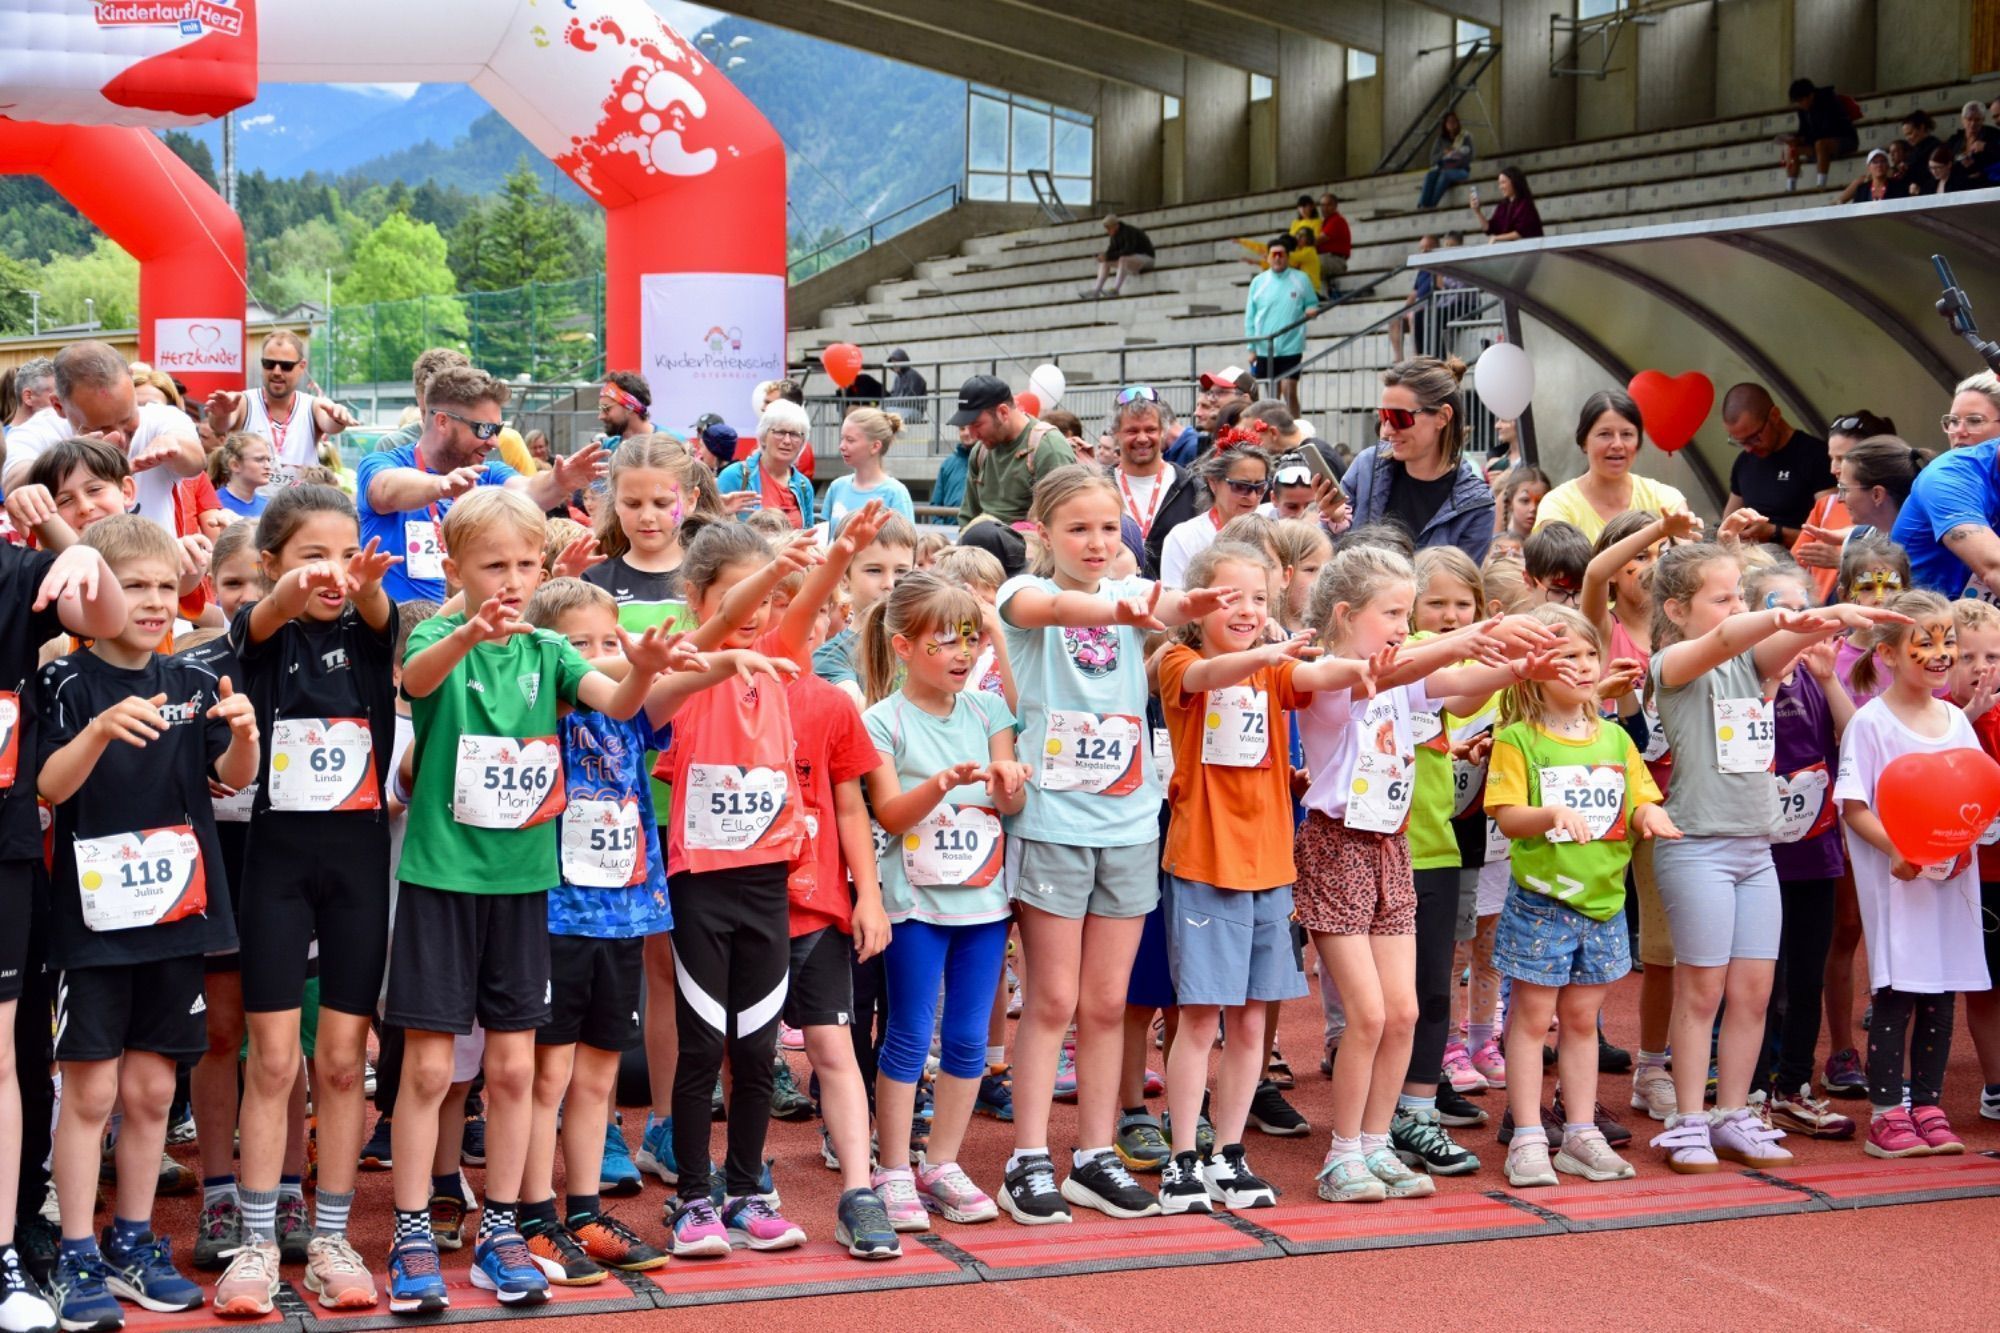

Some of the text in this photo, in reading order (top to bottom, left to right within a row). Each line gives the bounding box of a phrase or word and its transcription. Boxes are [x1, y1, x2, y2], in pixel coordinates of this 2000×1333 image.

[97, 2, 193, 22] Kinderlauf
[199, 5, 239, 31] Herz
[182, 22, 199, 33] mit
[466, 678, 485, 693] JAKO
[1242, 711, 1265, 734] 72
[310, 747, 346, 772] 69
[1075, 737, 1122, 761] 124
[1075, 760, 1121, 771] Magdalena
[314, 774, 343, 783] Linda
[483, 765, 547, 790] 5166
[711, 791, 774, 815] 5138
[1564, 787, 1617, 808] 5206
[721, 818, 756, 833] Ella
[934, 829, 979, 852] 110
[942, 852, 973, 861] Rosalie
[120, 857, 173, 888] 118
[133, 886, 165, 899] Julius
